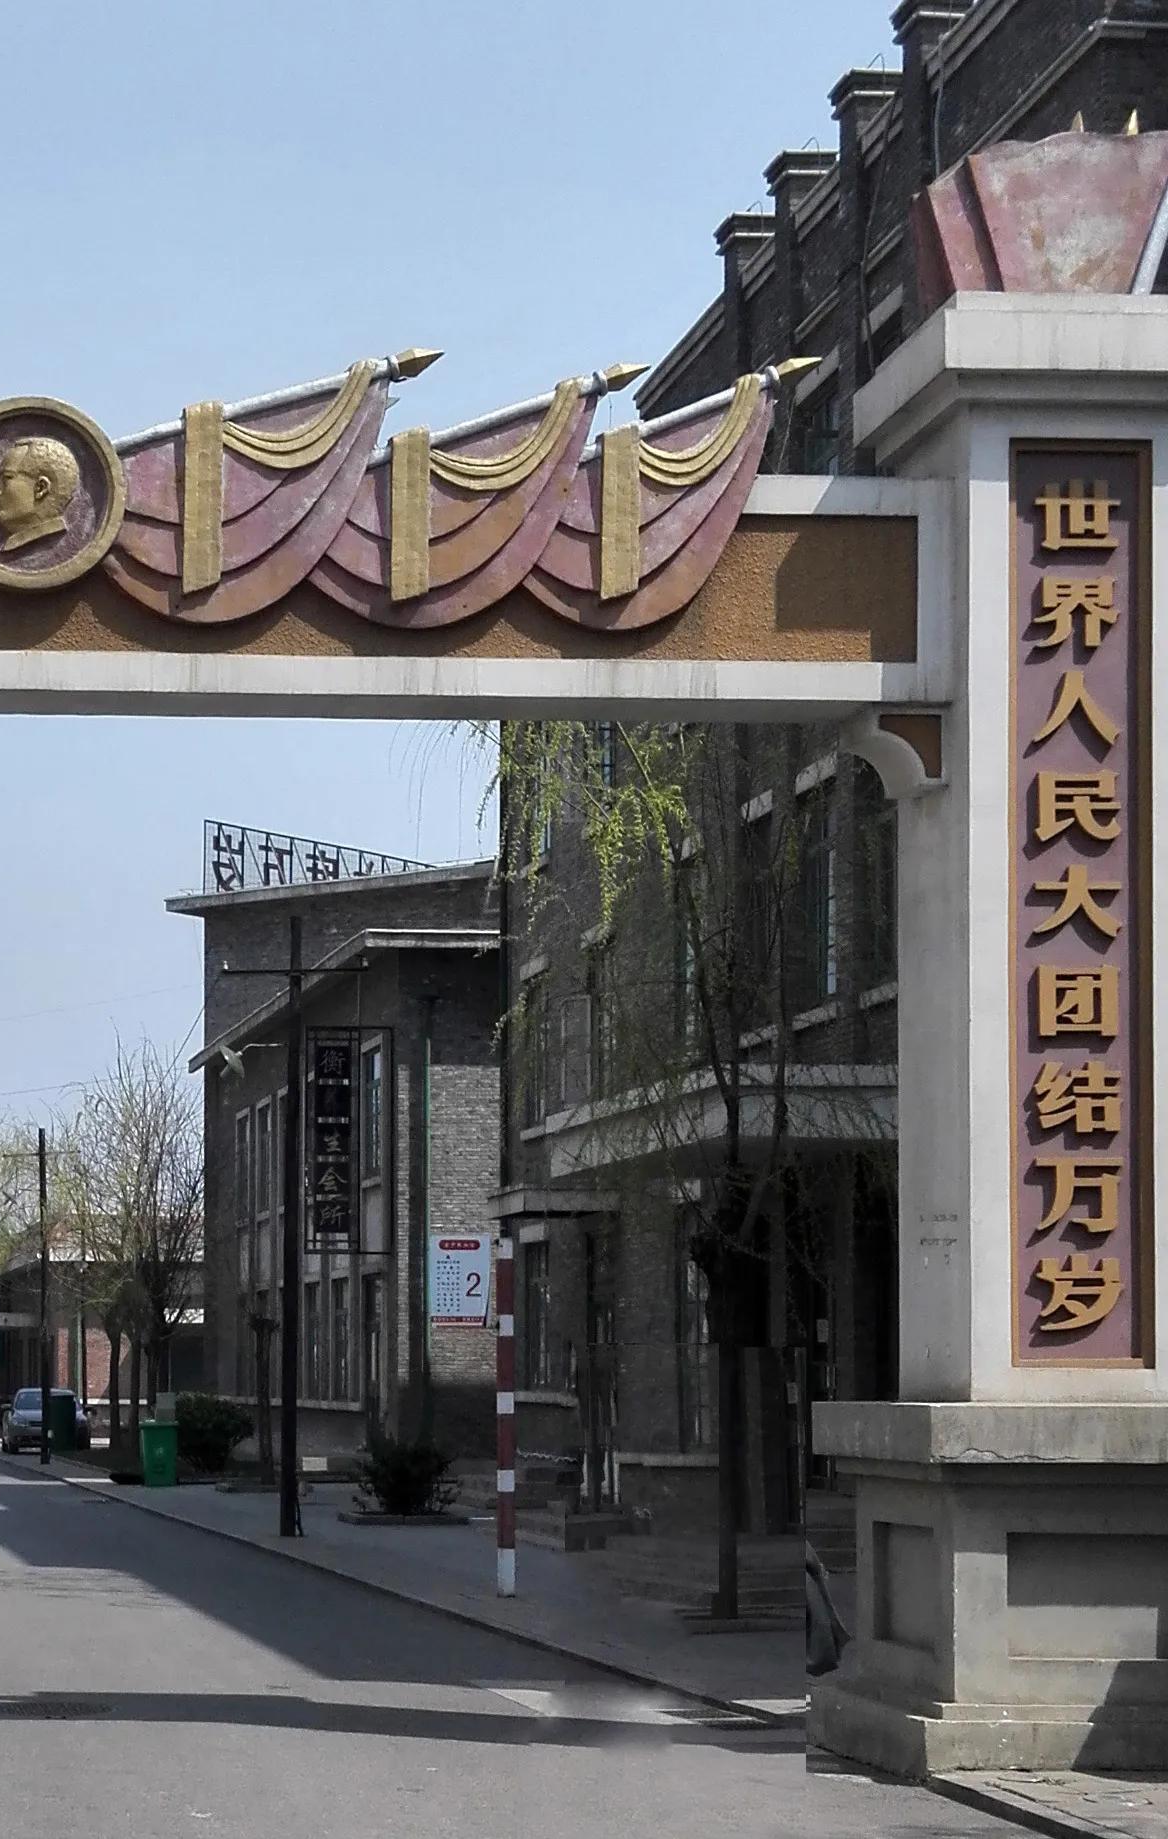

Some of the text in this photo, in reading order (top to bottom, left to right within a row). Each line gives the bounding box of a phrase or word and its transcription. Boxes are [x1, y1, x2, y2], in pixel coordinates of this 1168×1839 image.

[1034, 479, 1125, 1331] 世界人民大团结万岁
[465, 1272, 482, 1297] 2
